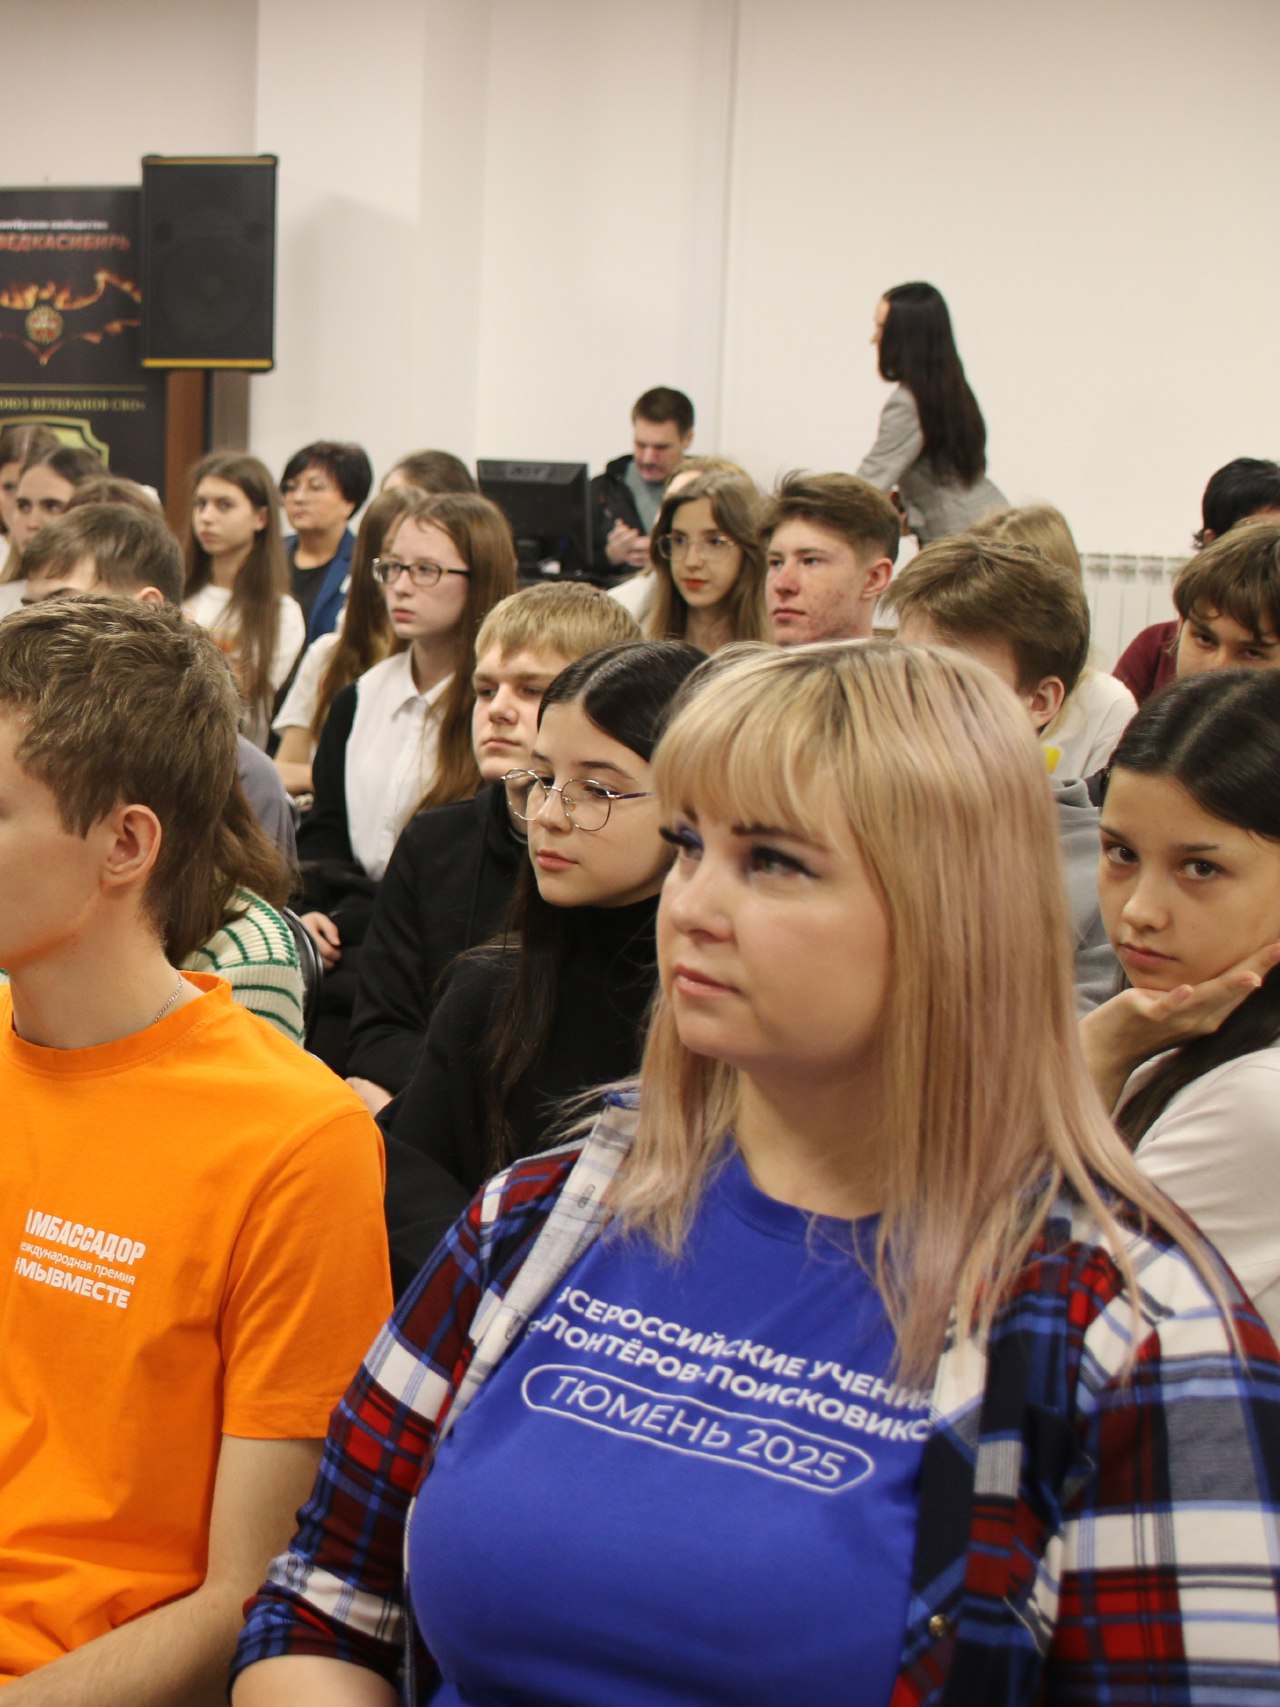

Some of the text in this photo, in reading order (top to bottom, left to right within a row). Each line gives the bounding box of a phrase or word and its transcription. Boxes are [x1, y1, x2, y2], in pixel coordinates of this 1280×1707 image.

[20, 1241, 136, 1286] еждународная премия
[550, 1374, 847, 1483] ТЮМЕНЬ 2025
